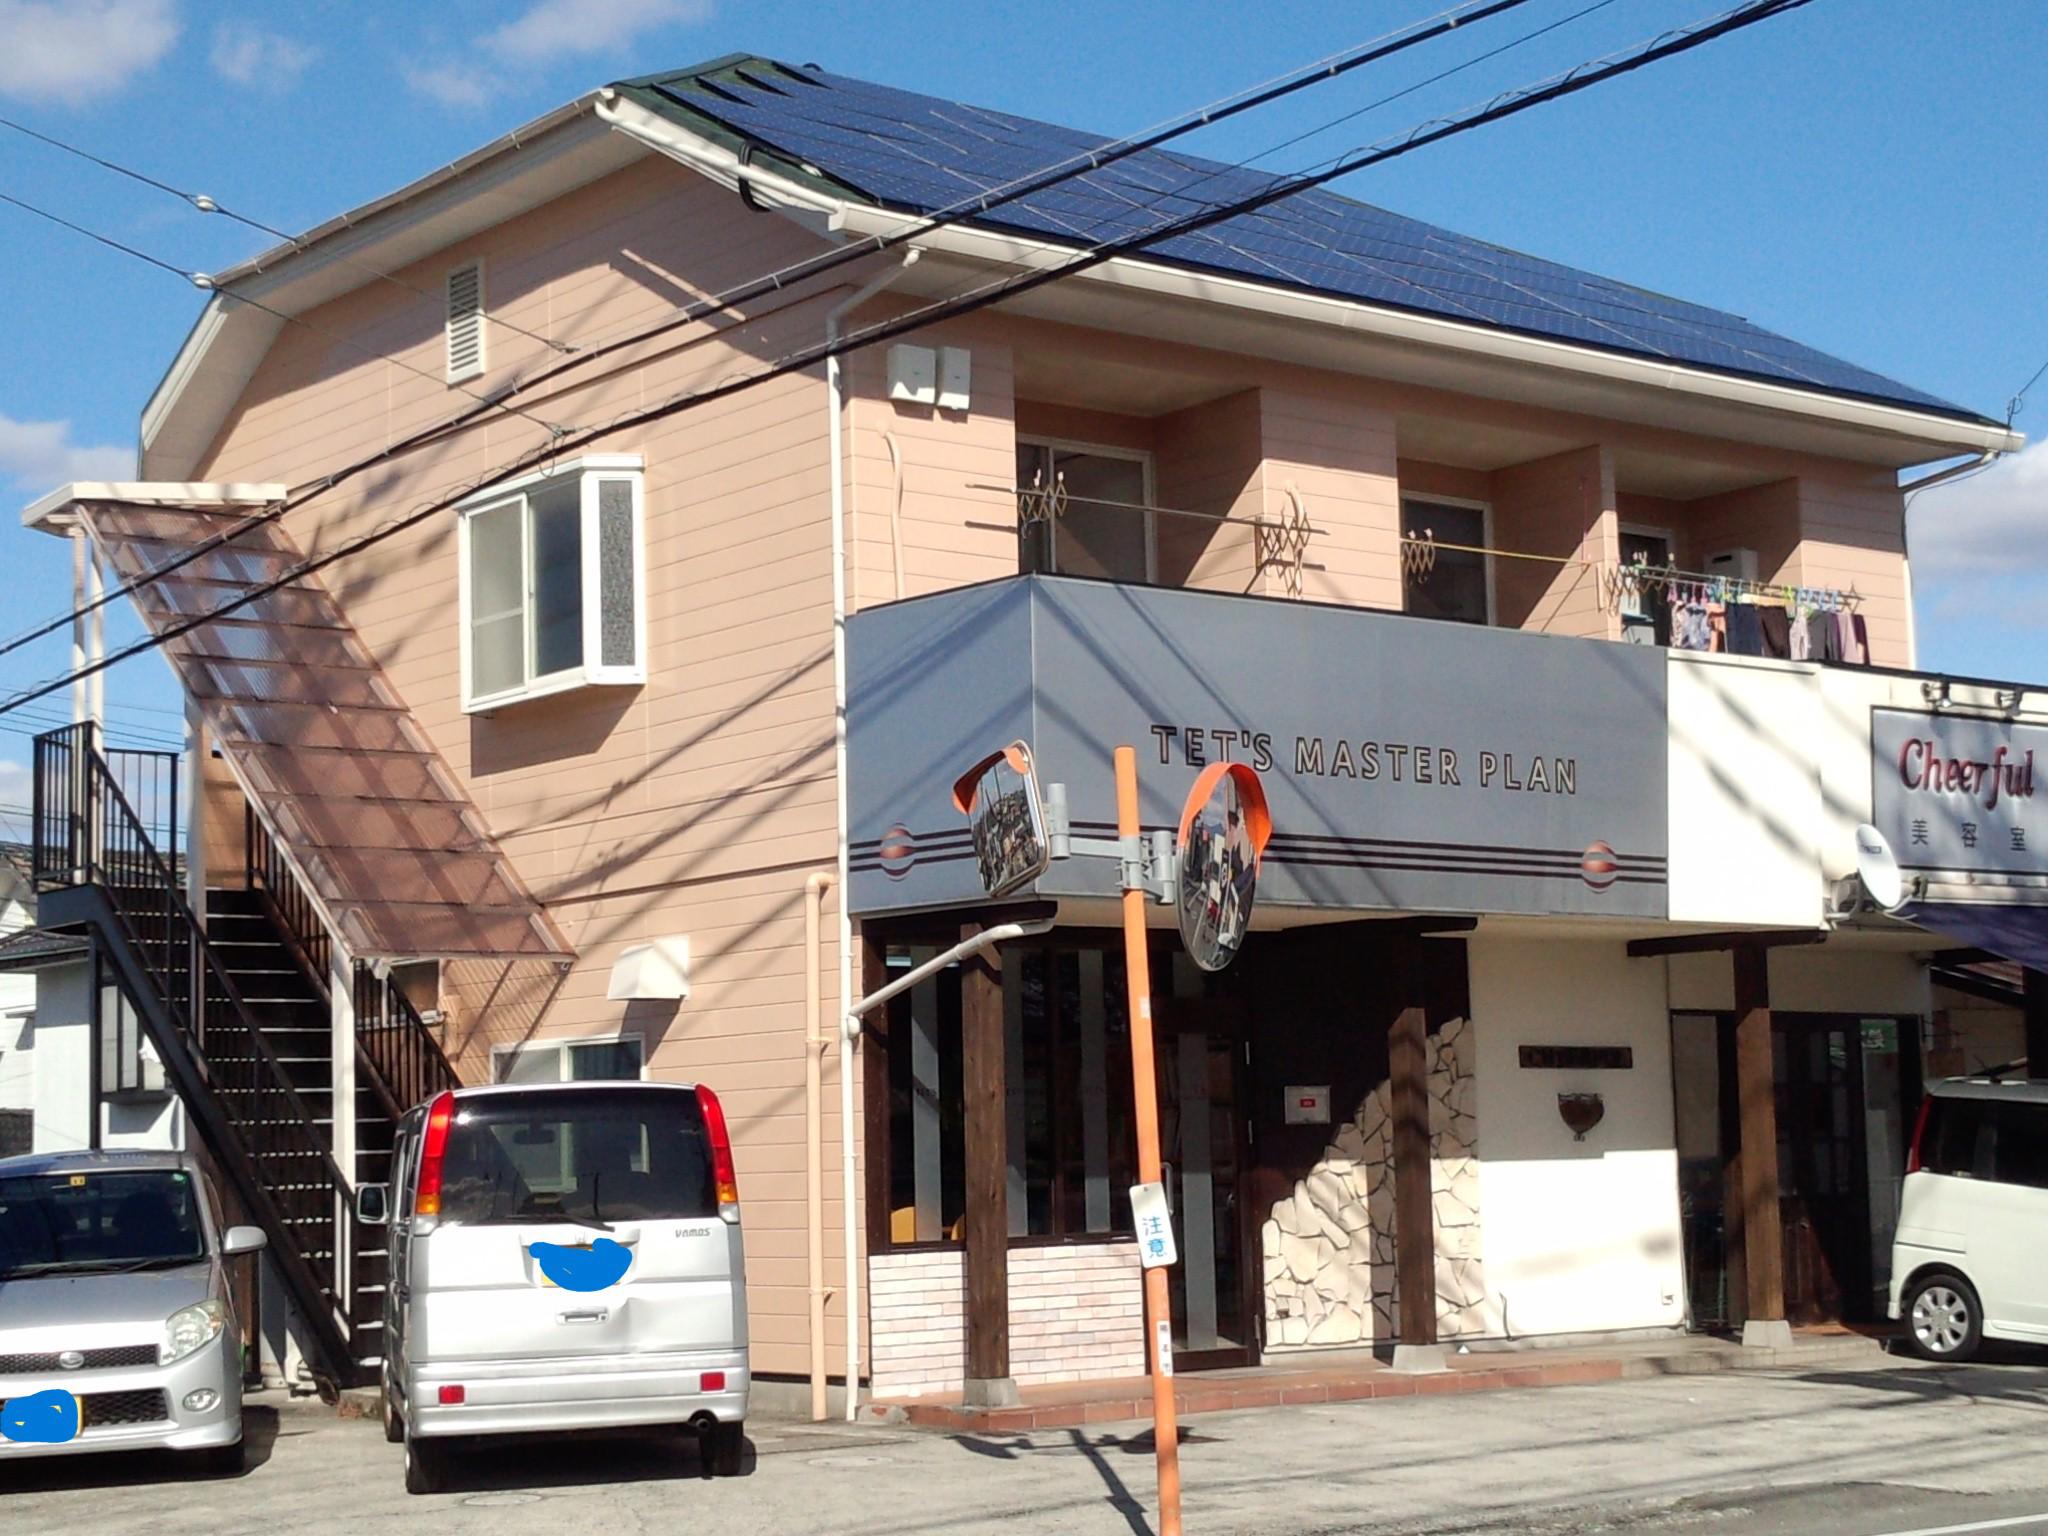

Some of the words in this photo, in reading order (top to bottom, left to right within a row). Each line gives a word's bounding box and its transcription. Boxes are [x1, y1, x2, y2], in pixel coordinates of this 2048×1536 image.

[1150, 724, 1273, 772] TET'S
[1295, 737, 1461, 785] MASTER
[1478, 751, 1577, 795] PLAN
[1899, 738, 2034, 810] Cheerful
[1911, 818, 2027, 852] 美容室
[1141, 1215, 1166, 1259] 注意
